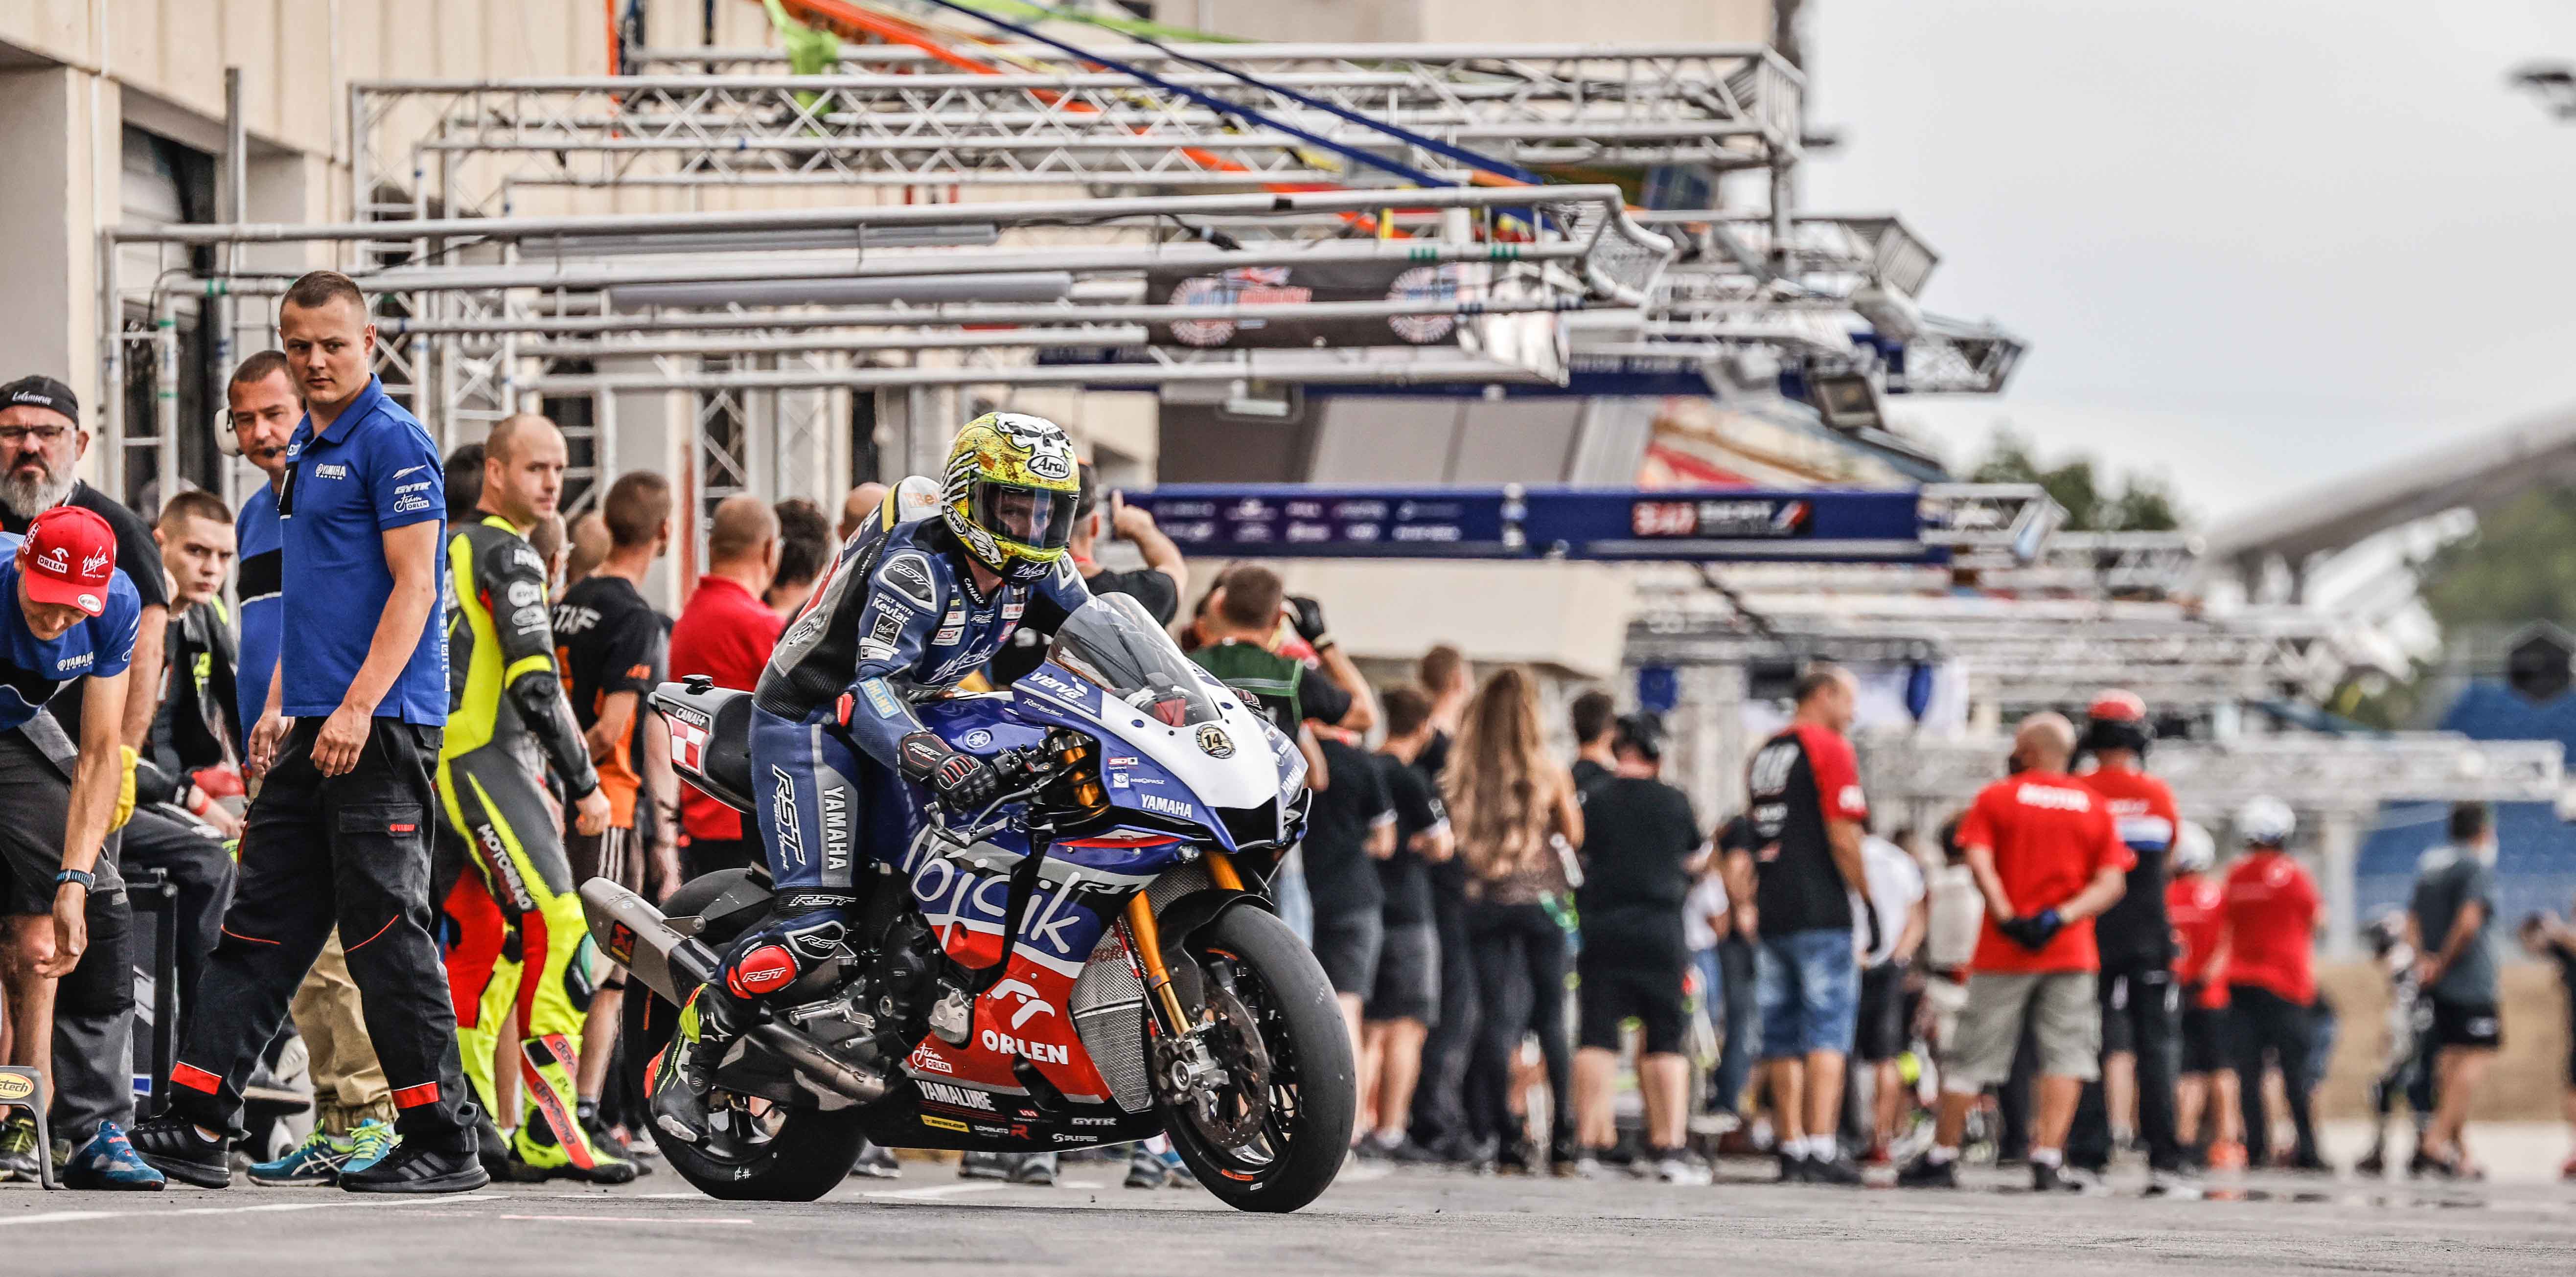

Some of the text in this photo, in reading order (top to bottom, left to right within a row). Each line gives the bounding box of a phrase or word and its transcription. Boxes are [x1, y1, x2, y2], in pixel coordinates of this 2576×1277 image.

[322, 464, 346, 477] YAMAHA
[1032, 457, 1066, 473] Arai
[946, 505, 964, 531] Arai
[39, 557, 65, 571] ORLEN
[885, 563, 931, 587] RST
[876, 592, 915, 616] BUILT WITH
[66, 651, 94, 668] YAMAHA
[1029, 672, 1085, 699] verva
[675, 707, 705, 726] CANAL+
[908, 742, 943, 756] RST
[1204, 733, 1222, 748] 14
[771, 764, 806, 866] RST
[1141, 794, 1193, 819] YAMAHA
[824, 785, 848, 870] YAMAHA
[788, 895, 857, 906] RST
[797, 935, 842, 949] RST
[742, 967, 787, 983] RST
[982, 1029, 1069, 1065] ORLEN
[0, 1079, 28, 1093] tech
[914, 1079, 997, 1112] YAMALUBE
[1071, 1117, 1116, 1125] GYTR
